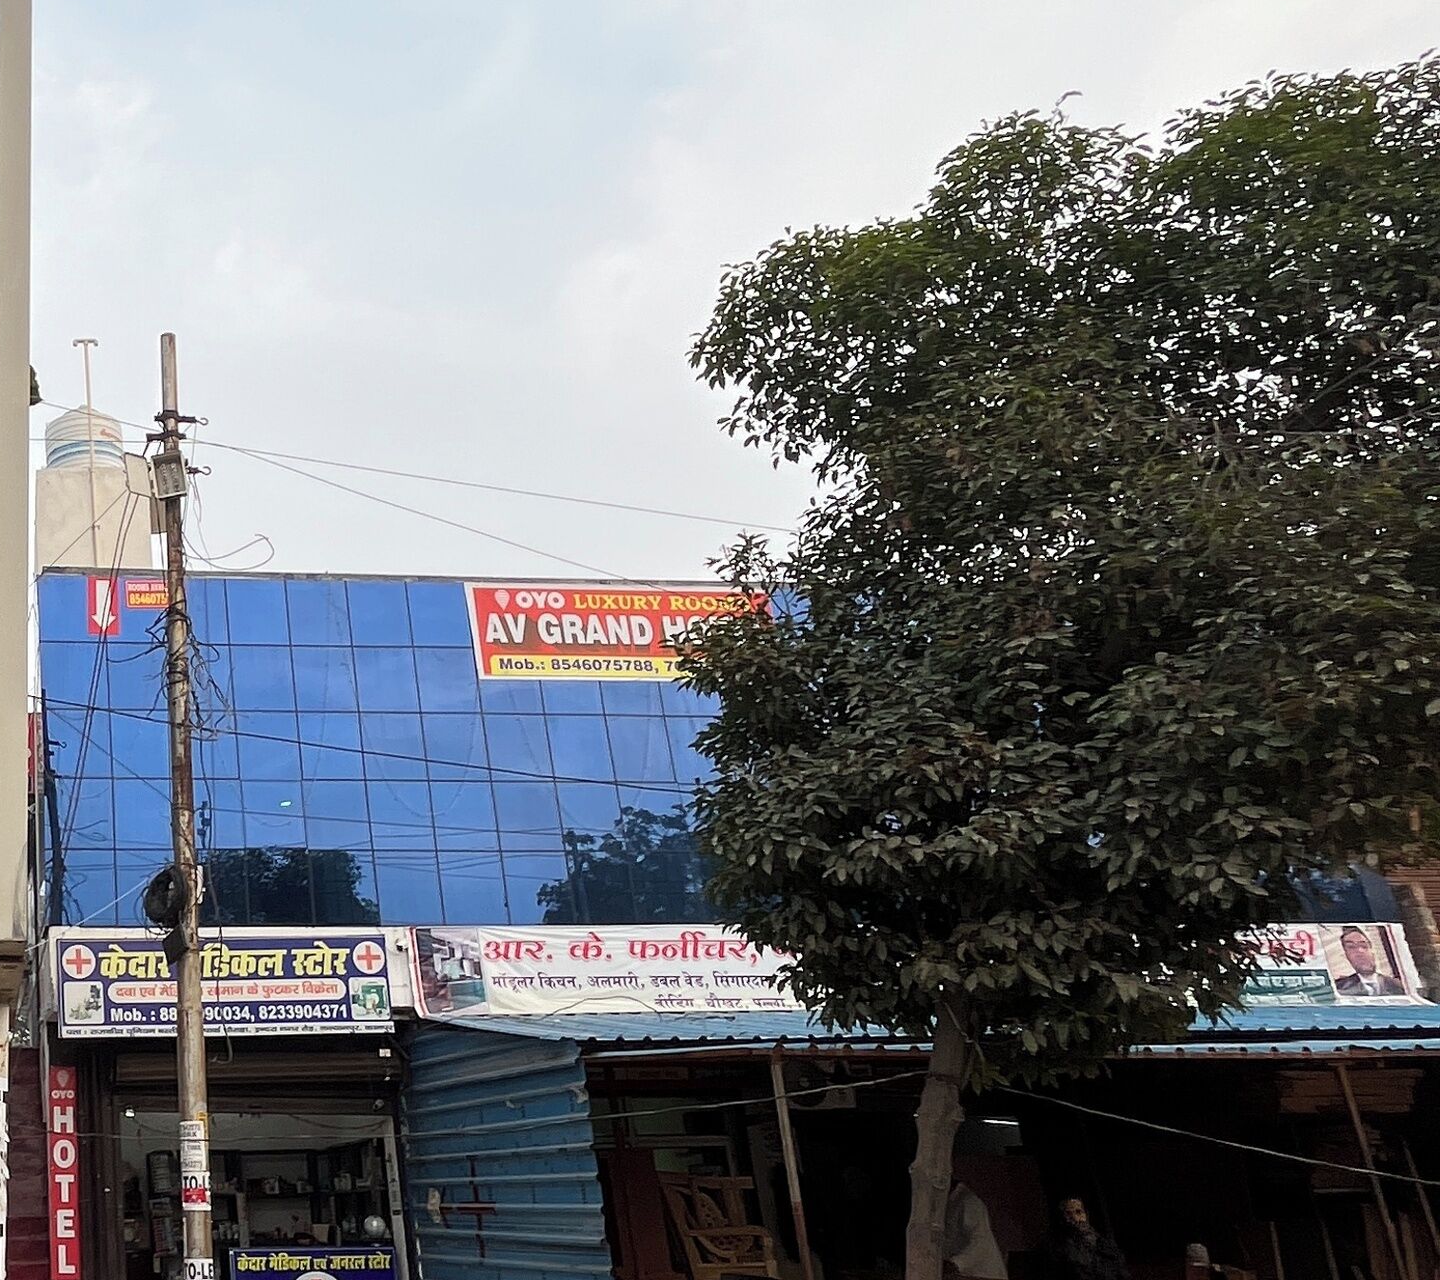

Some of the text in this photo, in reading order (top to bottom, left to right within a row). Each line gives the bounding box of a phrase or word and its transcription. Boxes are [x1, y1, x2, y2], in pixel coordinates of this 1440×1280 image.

[515, 591, 565, 609] OYO
[573, 594, 662, 611] LUXURY
[485, 613, 527, 644] AV
[537, 613, 654, 647] GRAND
[499, 658, 545, 671] Mob.:
[551, 659, 659, 673] 8546075788,
[483, 940, 553, 962] आर.
[569, 931, 613, 962] के.
[198, 942, 288, 979] डिकल
[291, 940, 351, 976] स्टोर
[537, 971, 582, 990] किचन,
[586, 971, 645, 989] अलमारी,
[110, 1007, 147, 1022] Mob.
[259, 1003, 348, 1020] 8233904371
[51, 1090, 75, 1099] OYO
[53, 1106, 76, 1274] HOTEL
[237, 1252, 267, 1271] केदार
[269, 1252, 312, 1271] मेडिकल
[329, 1254, 366, 1270] जनरल
[368, 1251, 392, 1269] स्टोर
